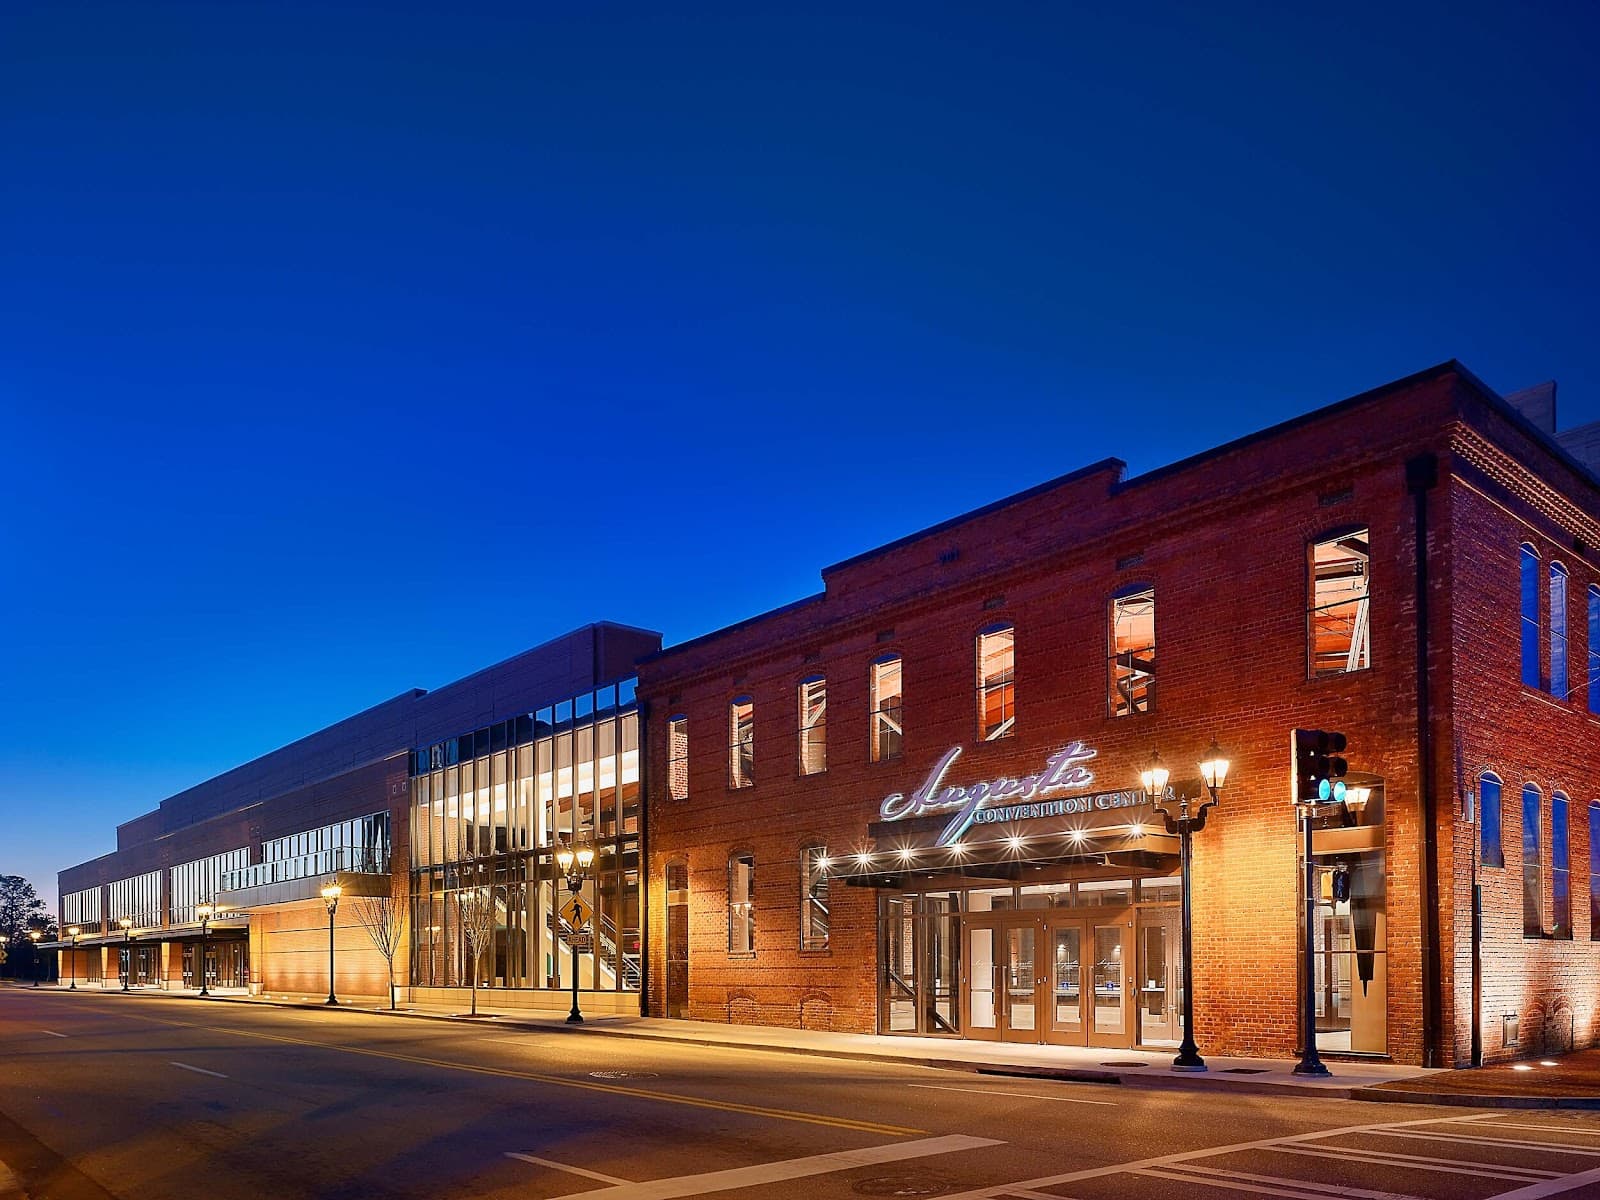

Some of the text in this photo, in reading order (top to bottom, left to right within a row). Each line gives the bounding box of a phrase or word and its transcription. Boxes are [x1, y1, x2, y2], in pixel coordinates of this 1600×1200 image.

[880, 741, 1097, 847] Augusta
[974, 785, 1176, 824] CONVENTION CENTR
